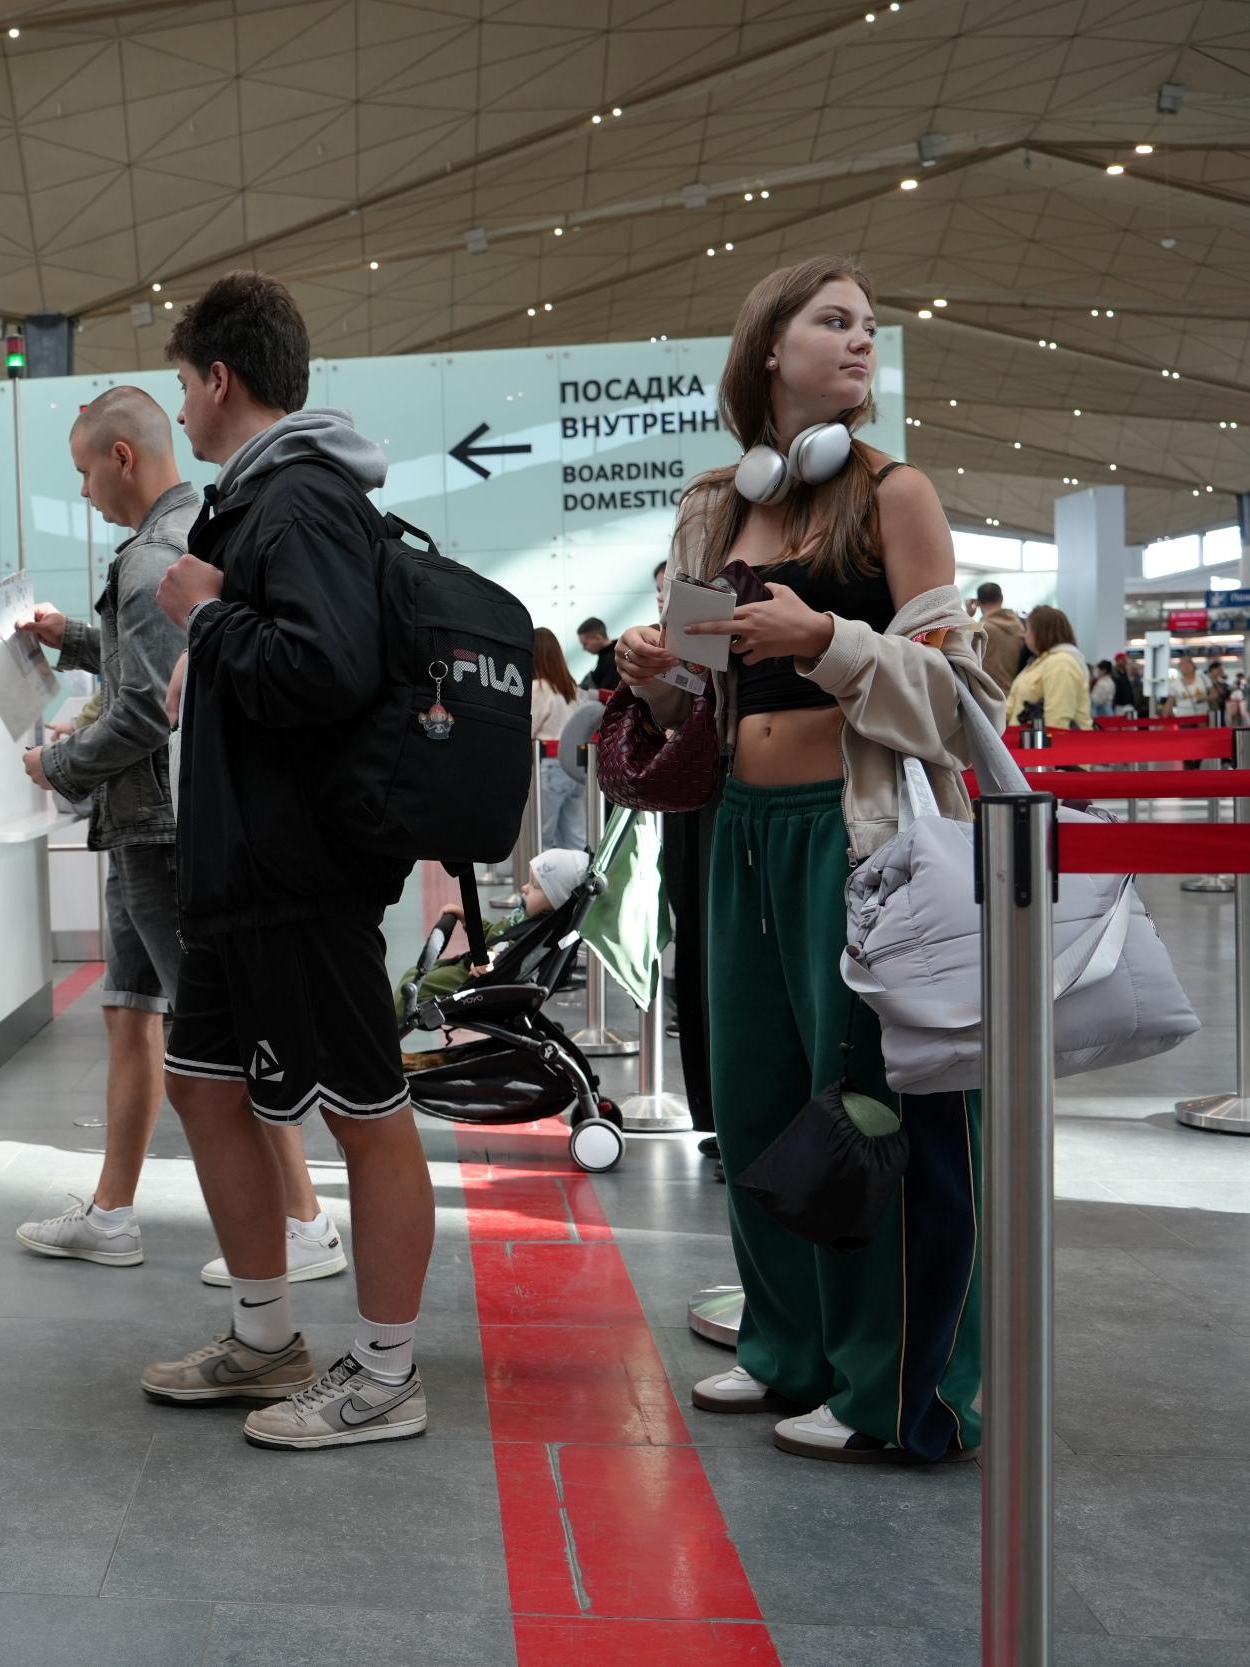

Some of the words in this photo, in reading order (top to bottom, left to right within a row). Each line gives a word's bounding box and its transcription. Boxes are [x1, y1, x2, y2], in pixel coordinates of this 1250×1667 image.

[560, 375, 704, 403] ПОСАДКА
[561, 409, 729, 438] ВНУТРЕНН
[563, 460, 684, 483] BOARDING
[563, 488, 682, 511] DOMESTIC
[452, 649, 525, 697] FILA
